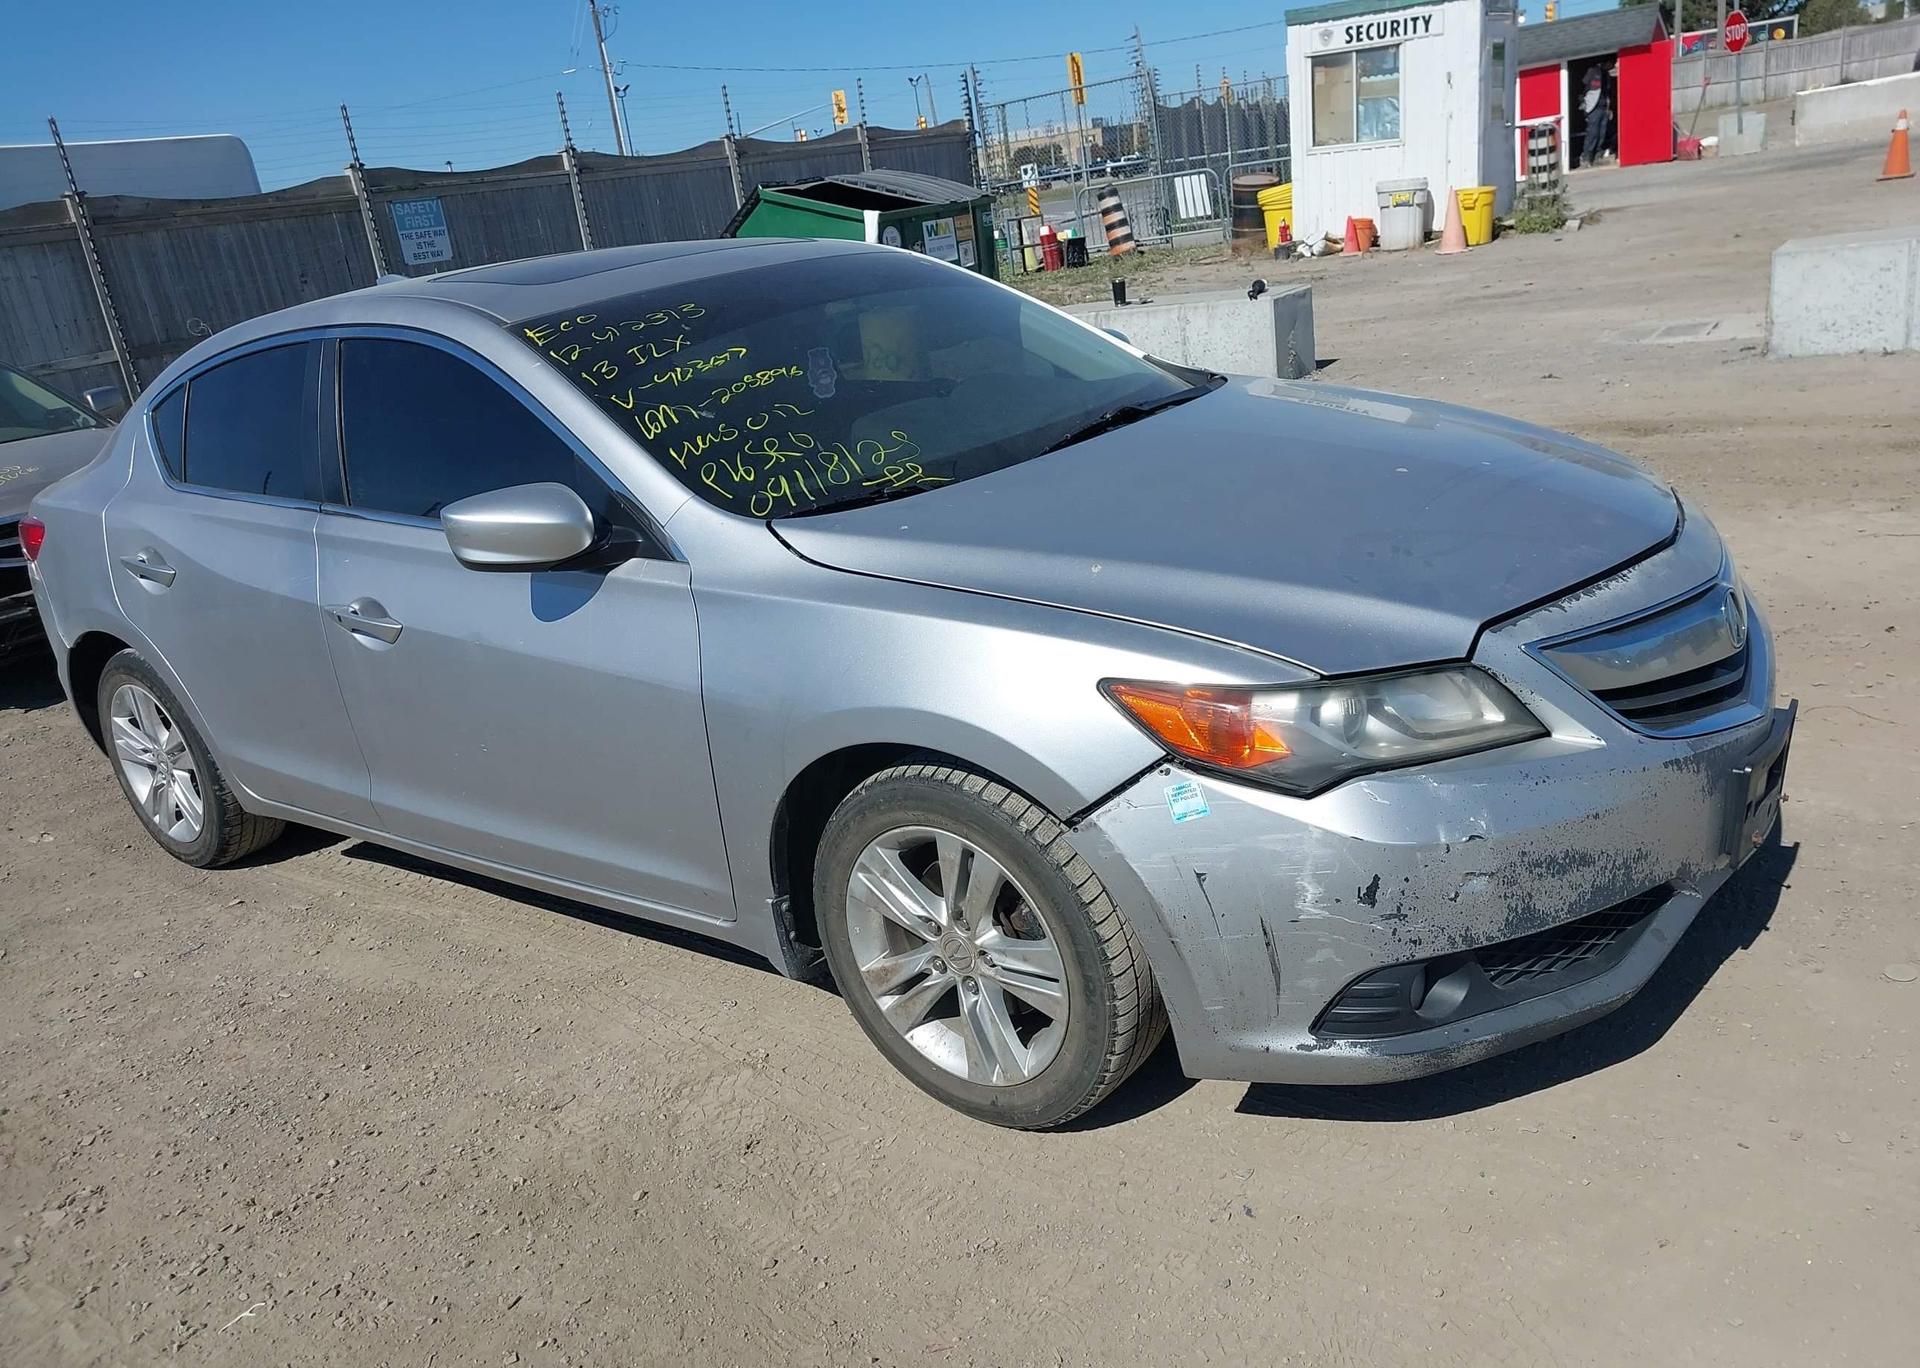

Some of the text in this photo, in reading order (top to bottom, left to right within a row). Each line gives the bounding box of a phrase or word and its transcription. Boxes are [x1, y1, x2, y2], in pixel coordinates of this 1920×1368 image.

[1345, 14, 1432, 44] SECURITY
[1726, 23, 1746, 43] STOP
[395, 200, 437, 215] SAFETY
[405, 215, 435, 228] FIRST
[400, 229, 447, 241] THE SAFE WAY
[417, 240, 437, 250] IS THE
[413, 249, 444, 261] BEST WAY
[581, 334, 692, 386] 13 ILX
